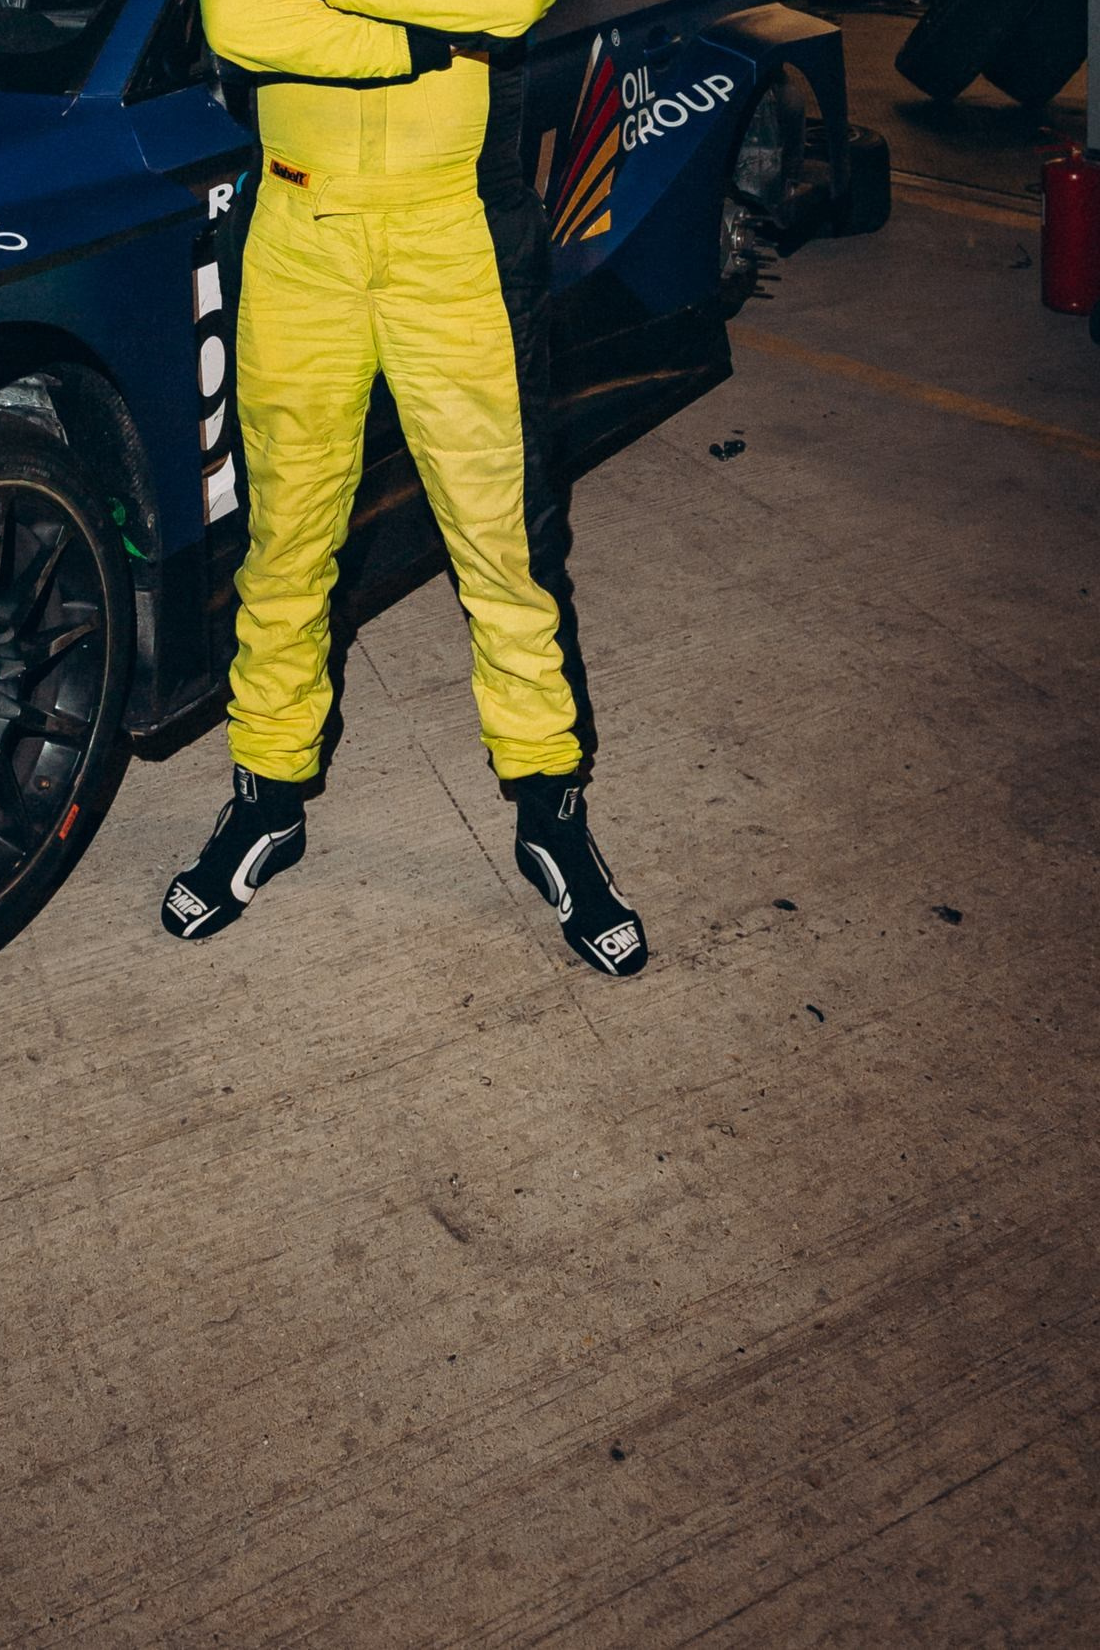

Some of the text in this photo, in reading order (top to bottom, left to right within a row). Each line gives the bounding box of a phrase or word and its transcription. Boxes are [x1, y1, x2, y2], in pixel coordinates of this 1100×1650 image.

[622, 65, 656, 110] OIL
[622, 73, 735, 152] GROUP
[271, 161, 308, 188] Sabelt
